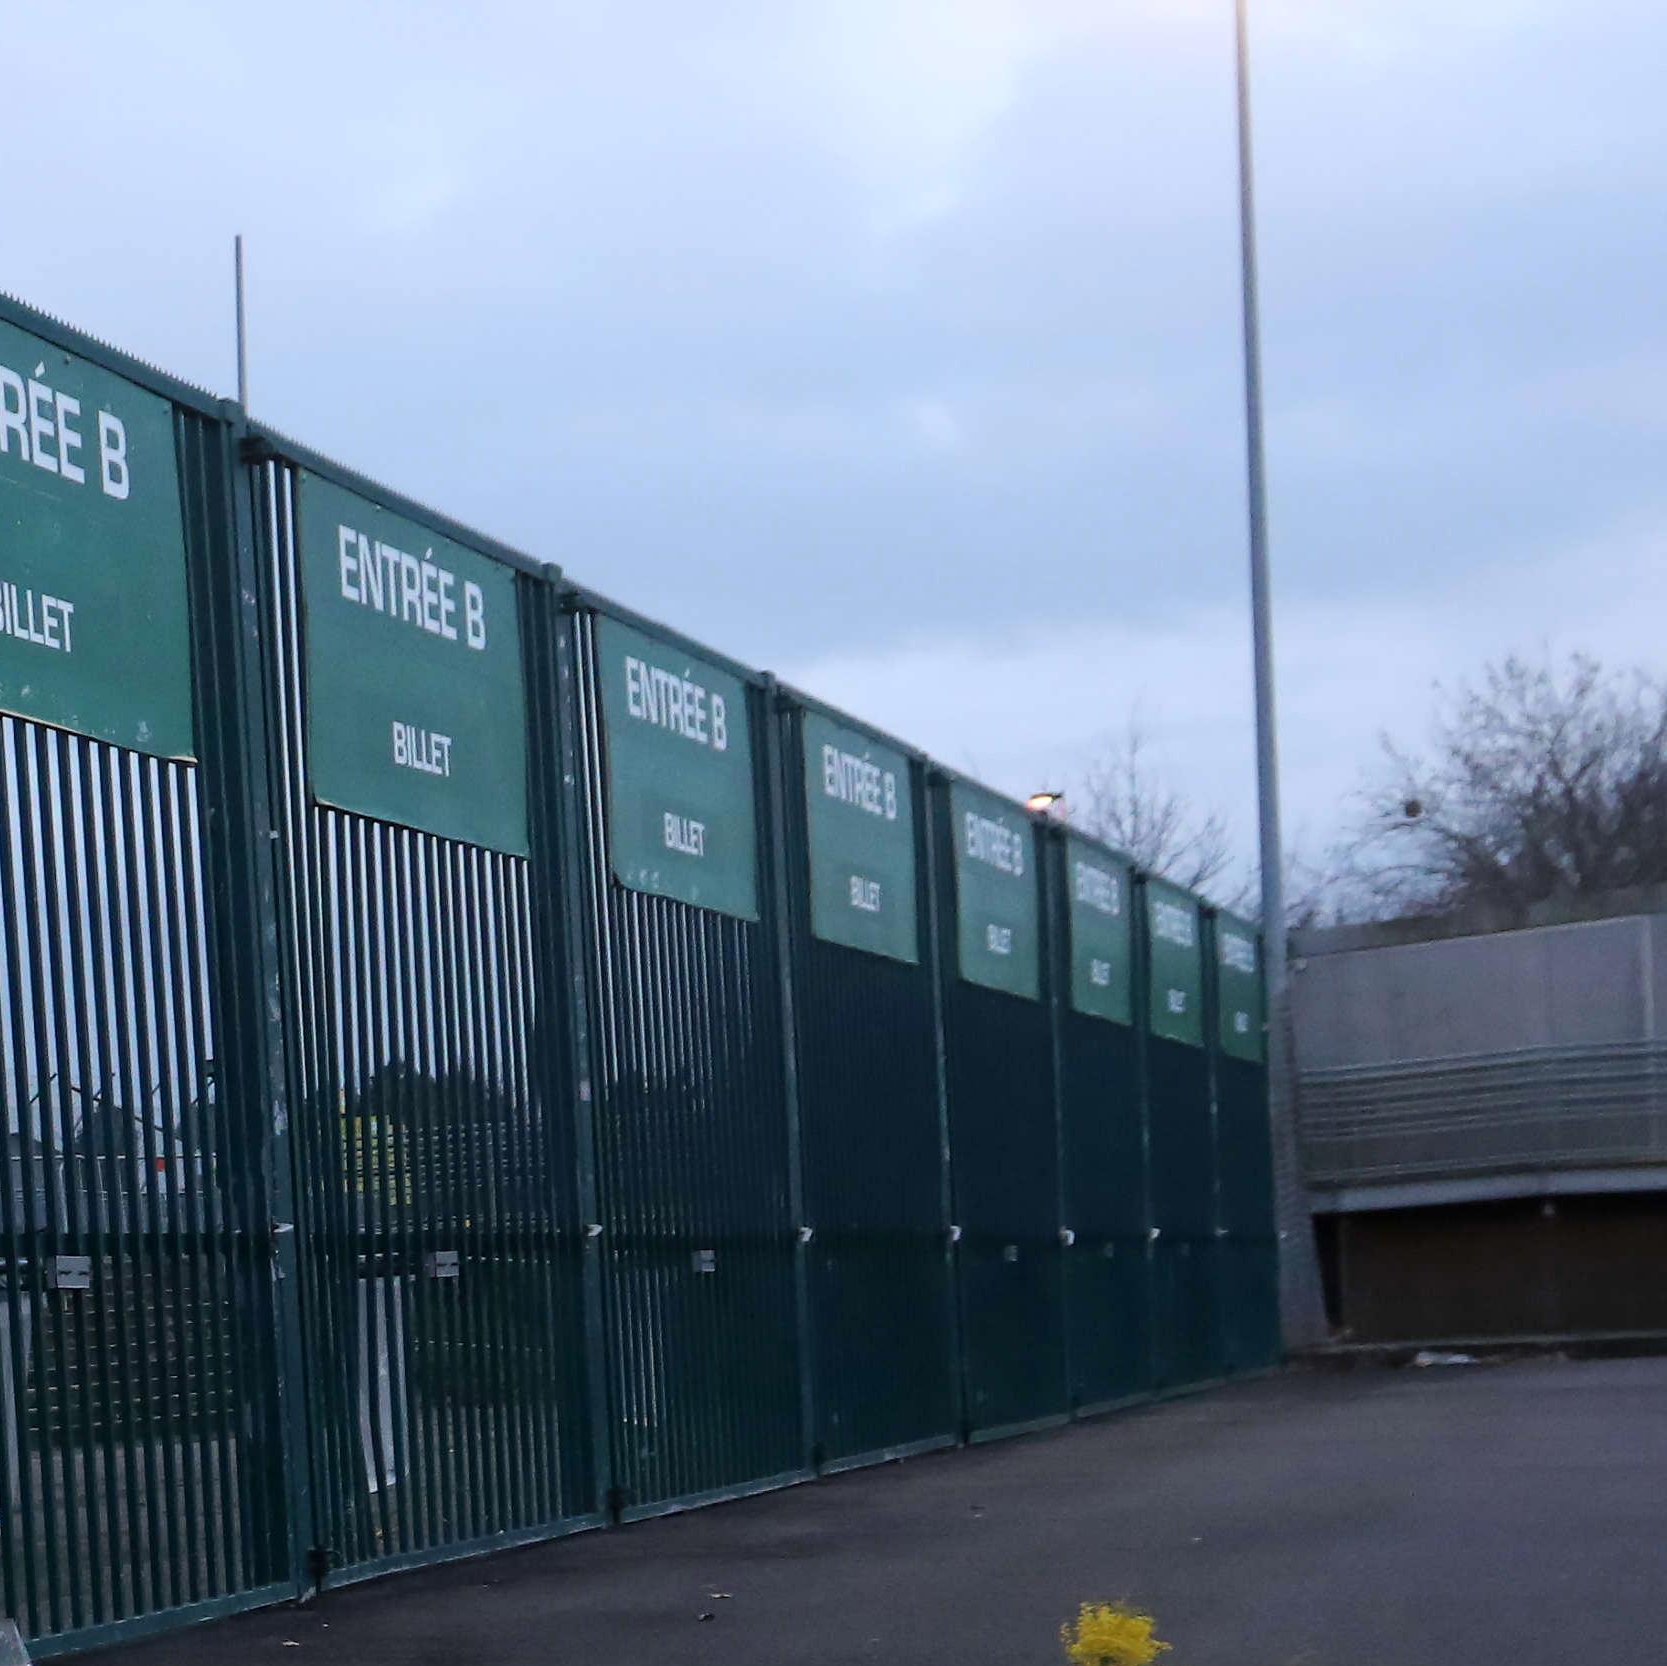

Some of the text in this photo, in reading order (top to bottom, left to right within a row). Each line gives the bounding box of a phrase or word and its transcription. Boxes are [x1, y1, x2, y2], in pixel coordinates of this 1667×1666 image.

[98, 409, 130, 500] B
[338, 524, 487, 650] ENTRÉE B
[392, 720, 453, 777] BILLET
[625, 655, 728, 751] ENTRÉE B
[663, 811, 706, 857] BILLET
